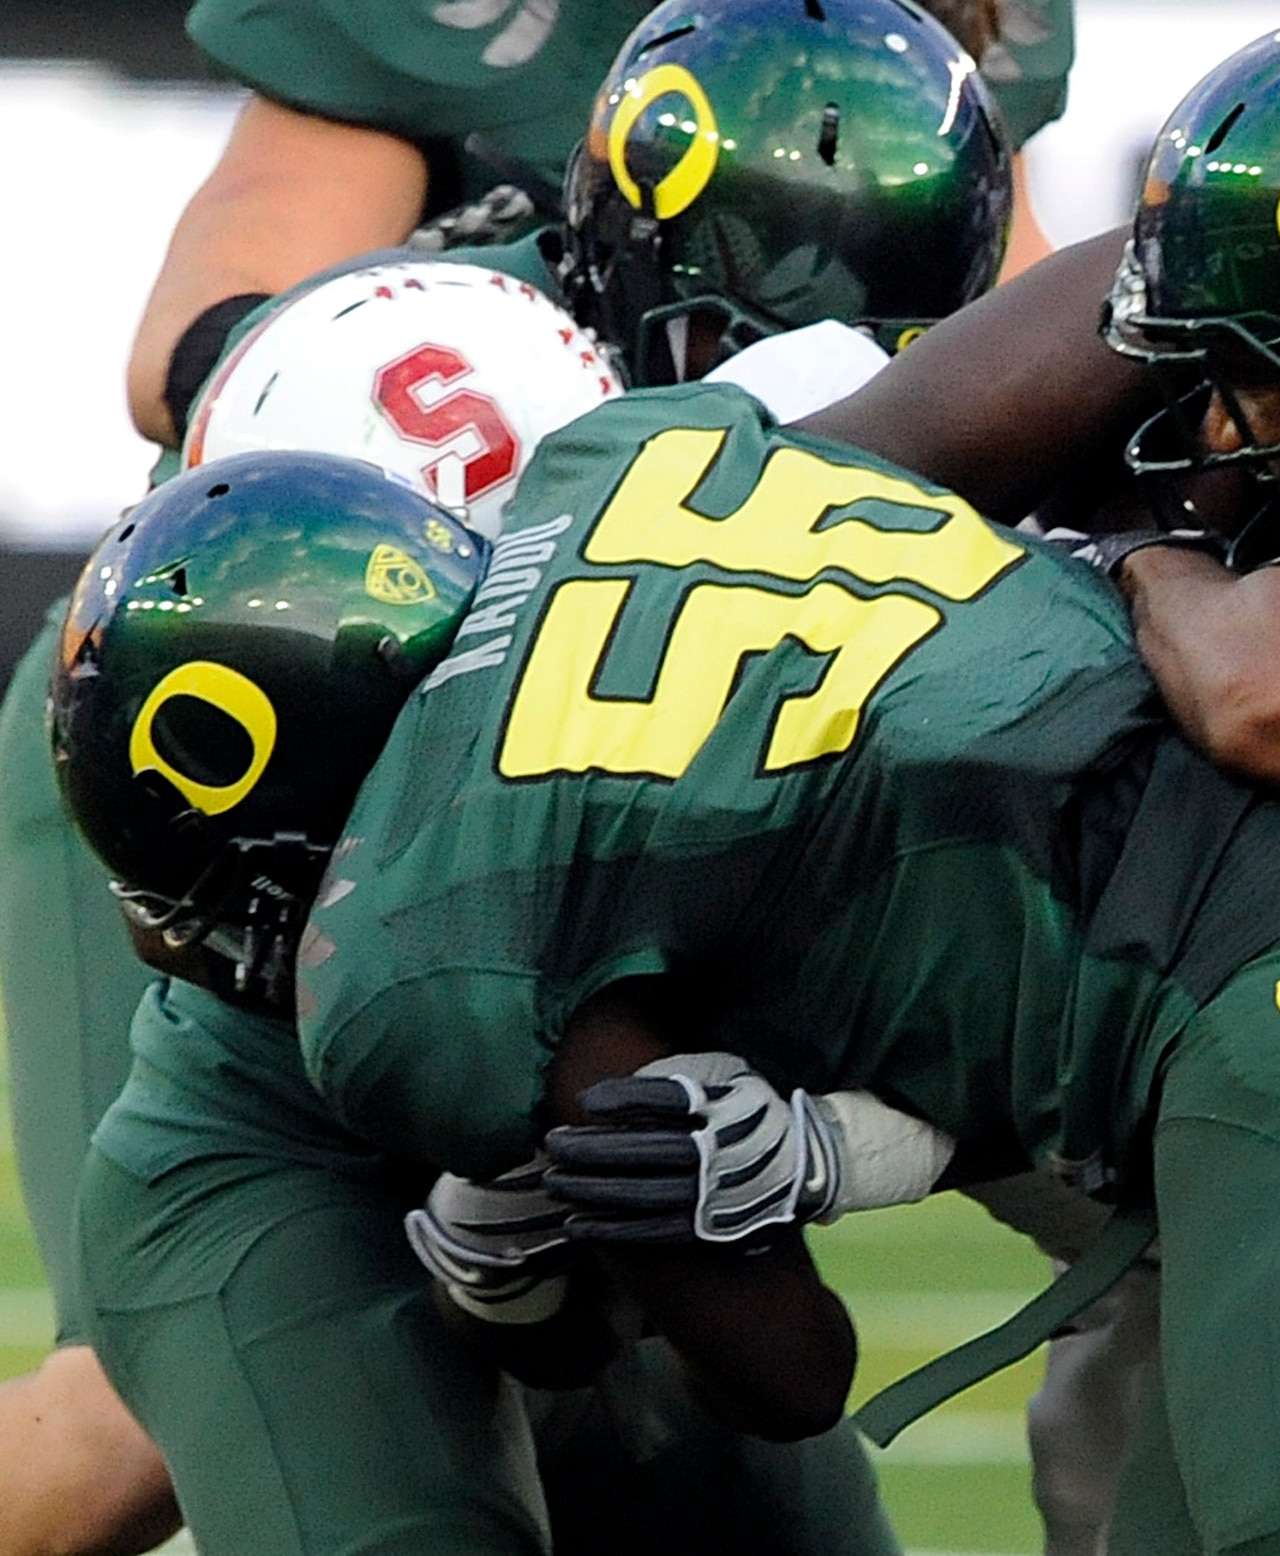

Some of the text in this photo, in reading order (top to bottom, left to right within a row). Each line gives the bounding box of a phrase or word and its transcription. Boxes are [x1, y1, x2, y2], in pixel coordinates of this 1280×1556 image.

[608, 63, 719, 220] O
[371, 342, 522, 505] S
[497, 425, 1034, 786] 56
[129, 660, 277, 817] O
